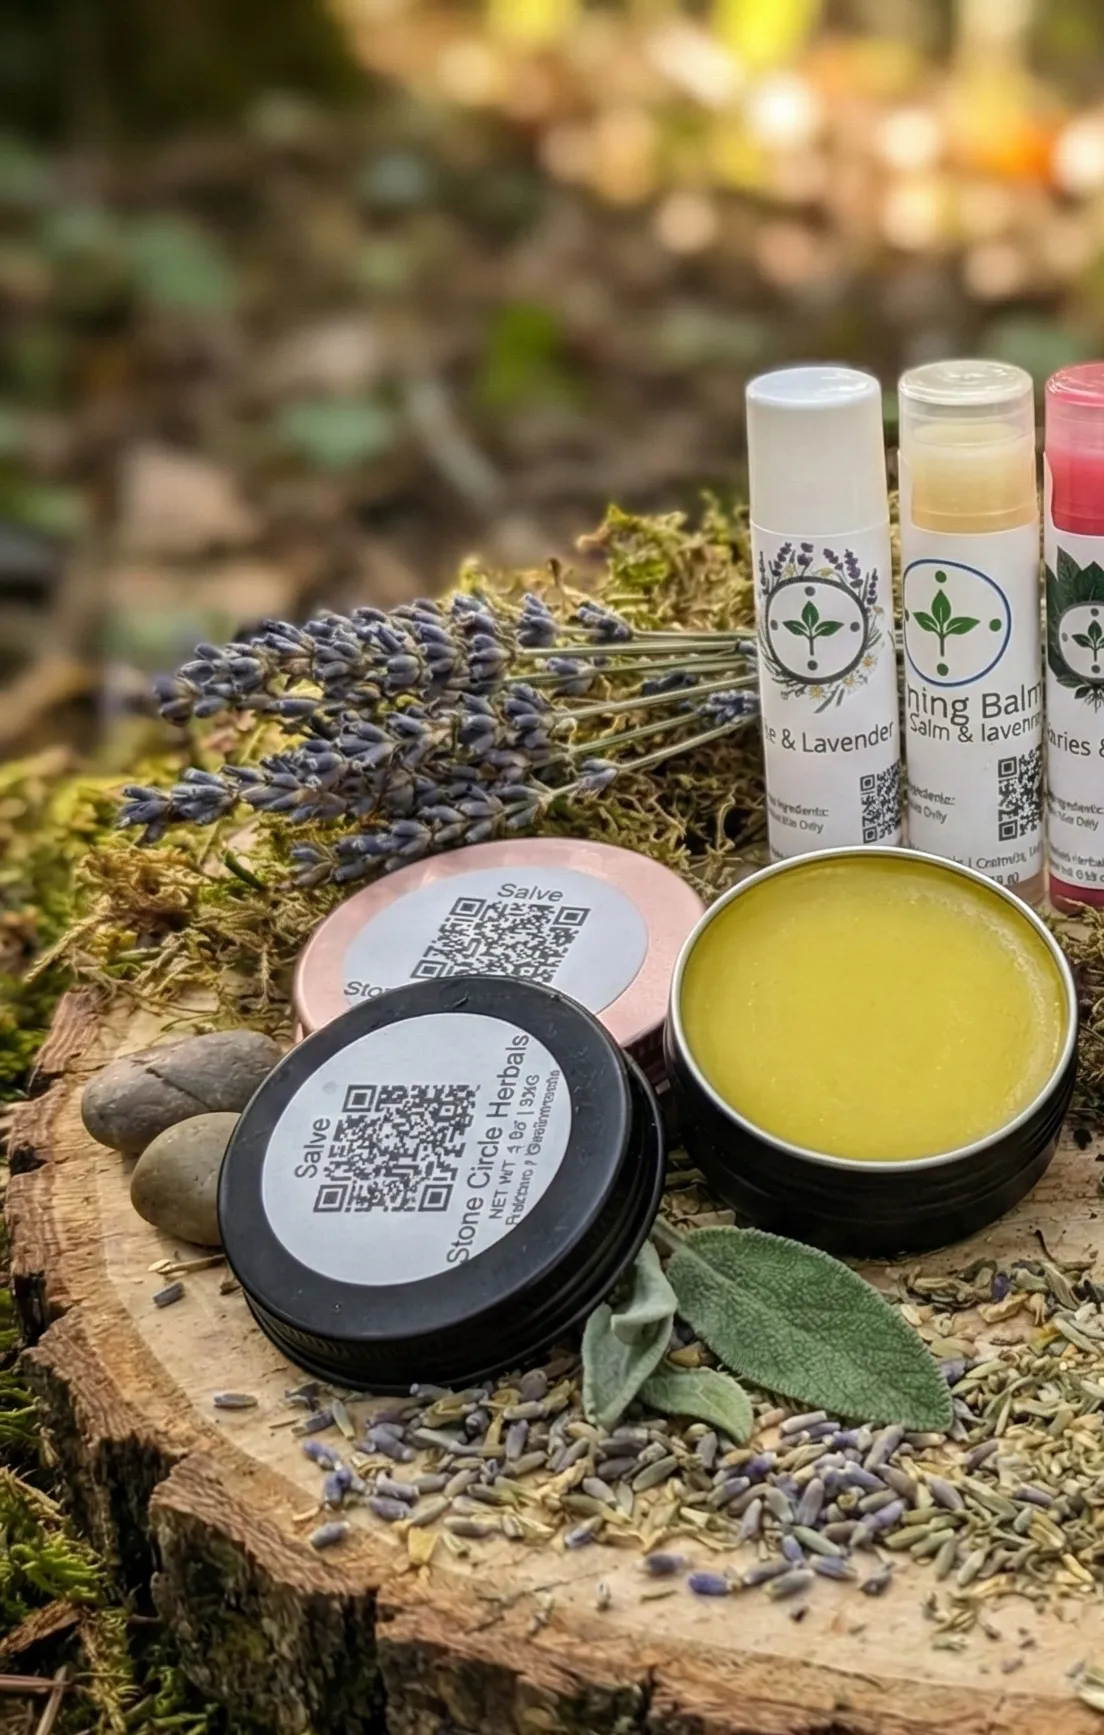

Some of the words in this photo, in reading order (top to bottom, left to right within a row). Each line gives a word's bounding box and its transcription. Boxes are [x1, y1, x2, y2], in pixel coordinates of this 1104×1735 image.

[781, 728, 796, 751] &
[802, 721, 894, 753] Lavender
[957, 725, 974, 743] &
[497, 883, 563, 902] Salve
[294, 1117, 331, 1179] Salve
[446, 1196, 484, 1264] Stone
[467, 1127, 503, 1189] Circle
[486, 1034, 529, 1117] Herbals
[489, 1189, 509, 1220] NET
